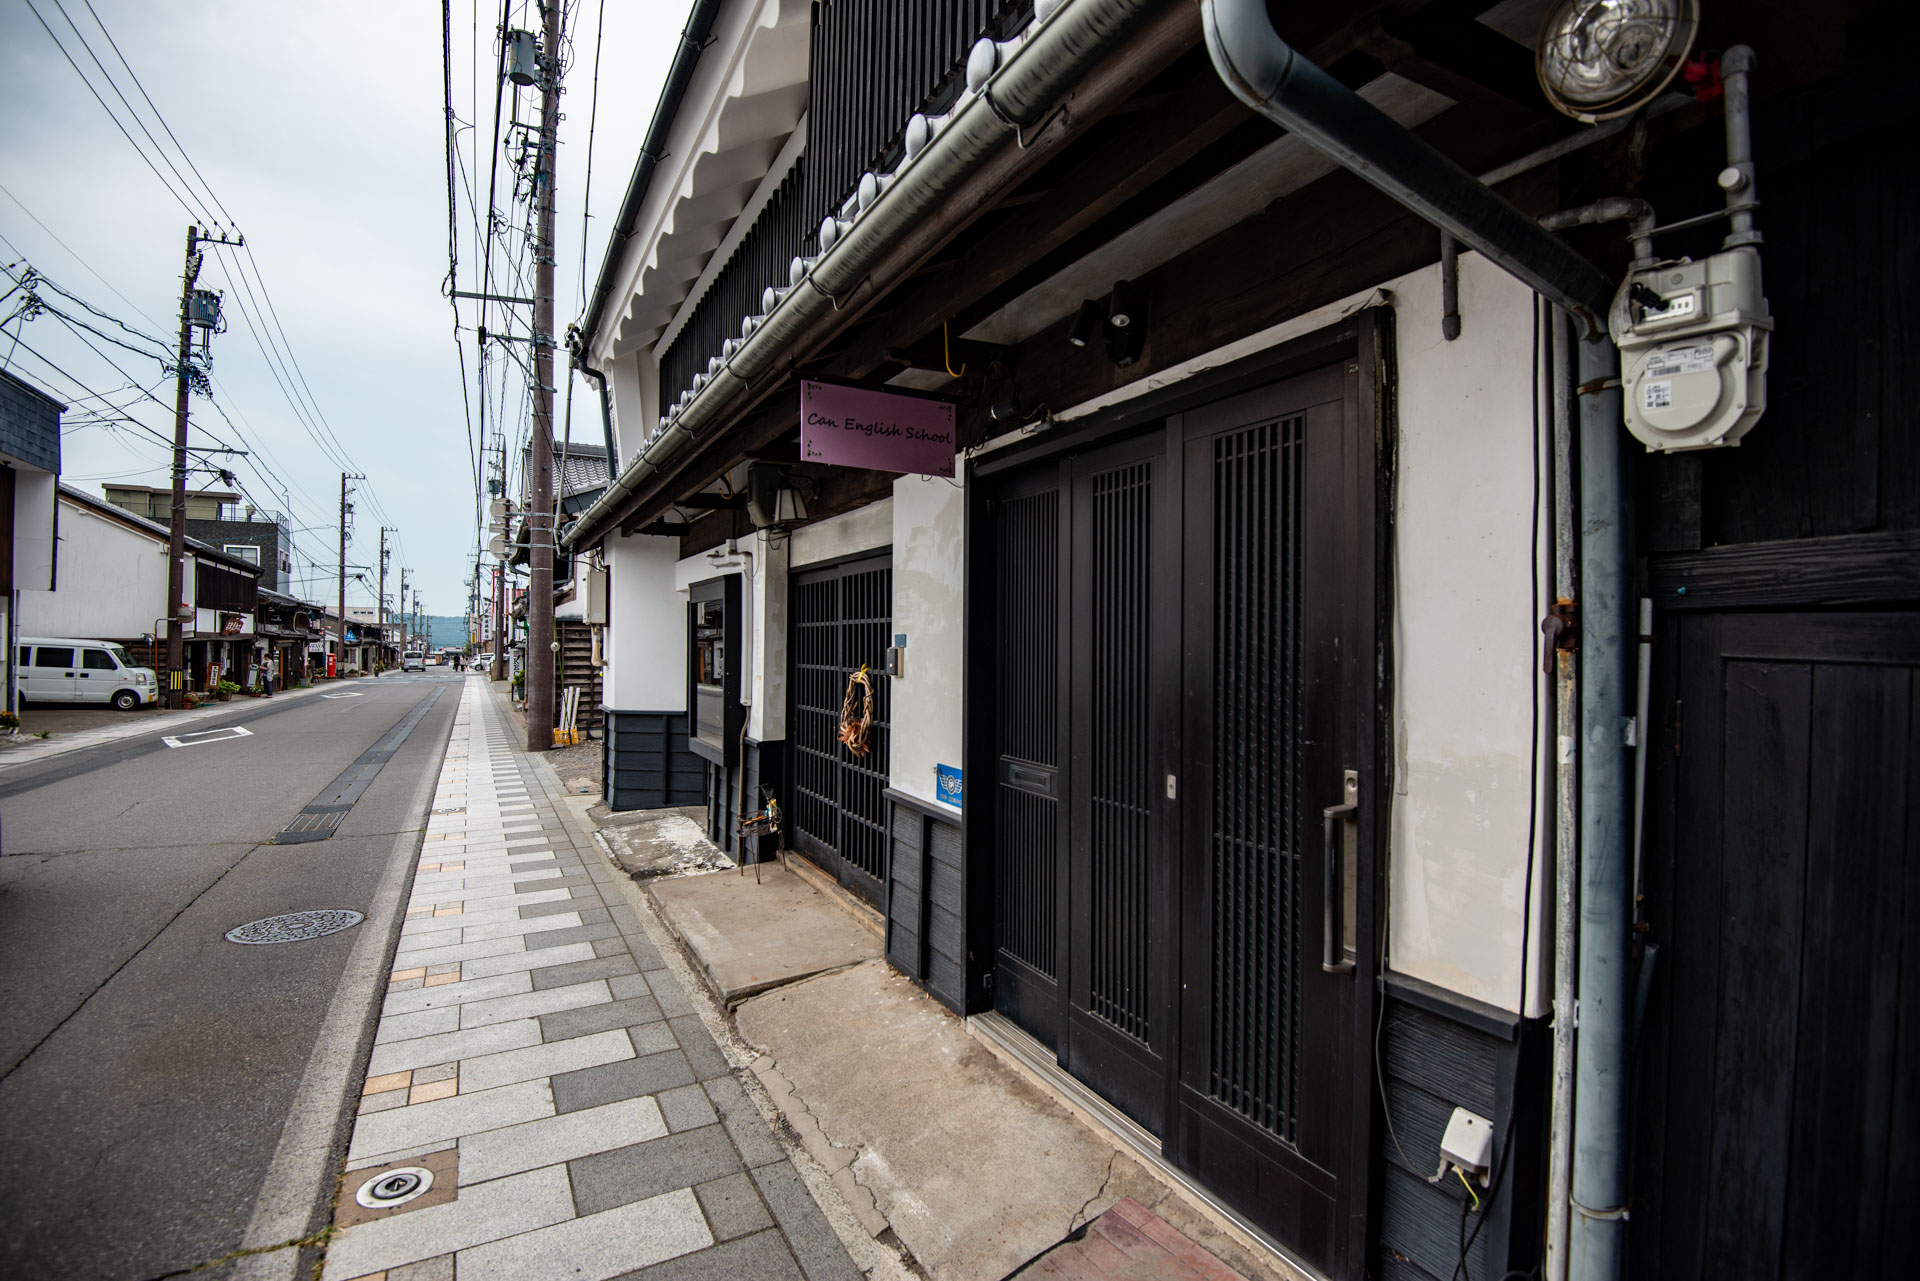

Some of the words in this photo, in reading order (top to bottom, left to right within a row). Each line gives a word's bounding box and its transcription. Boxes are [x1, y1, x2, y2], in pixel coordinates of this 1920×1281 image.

[808, 413, 838, 428] Can
[844, 418, 902, 437] English
[905, 427, 952, 444] School
